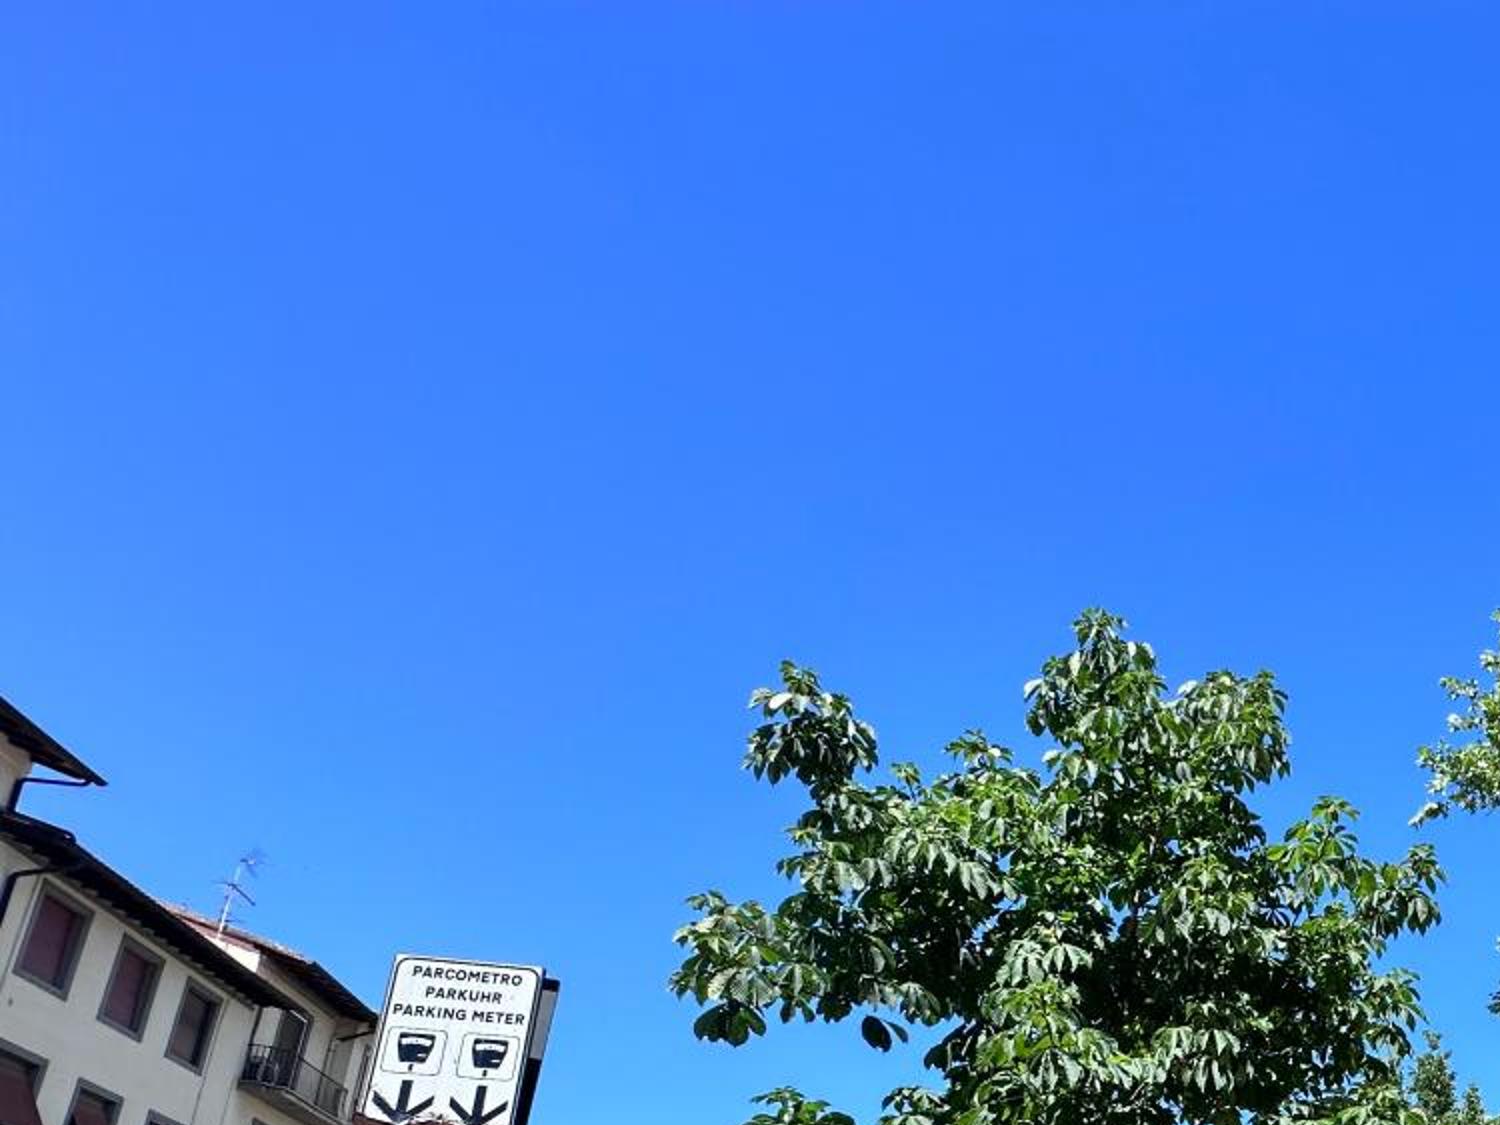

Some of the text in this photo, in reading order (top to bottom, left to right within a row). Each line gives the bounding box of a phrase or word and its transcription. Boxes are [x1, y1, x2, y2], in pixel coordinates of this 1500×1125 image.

[412, 965, 523, 986] PARCOMETRO
[425, 985, 502, 1004] PARKUHR
[392, 1003, 525, 1025] PARKING METER
